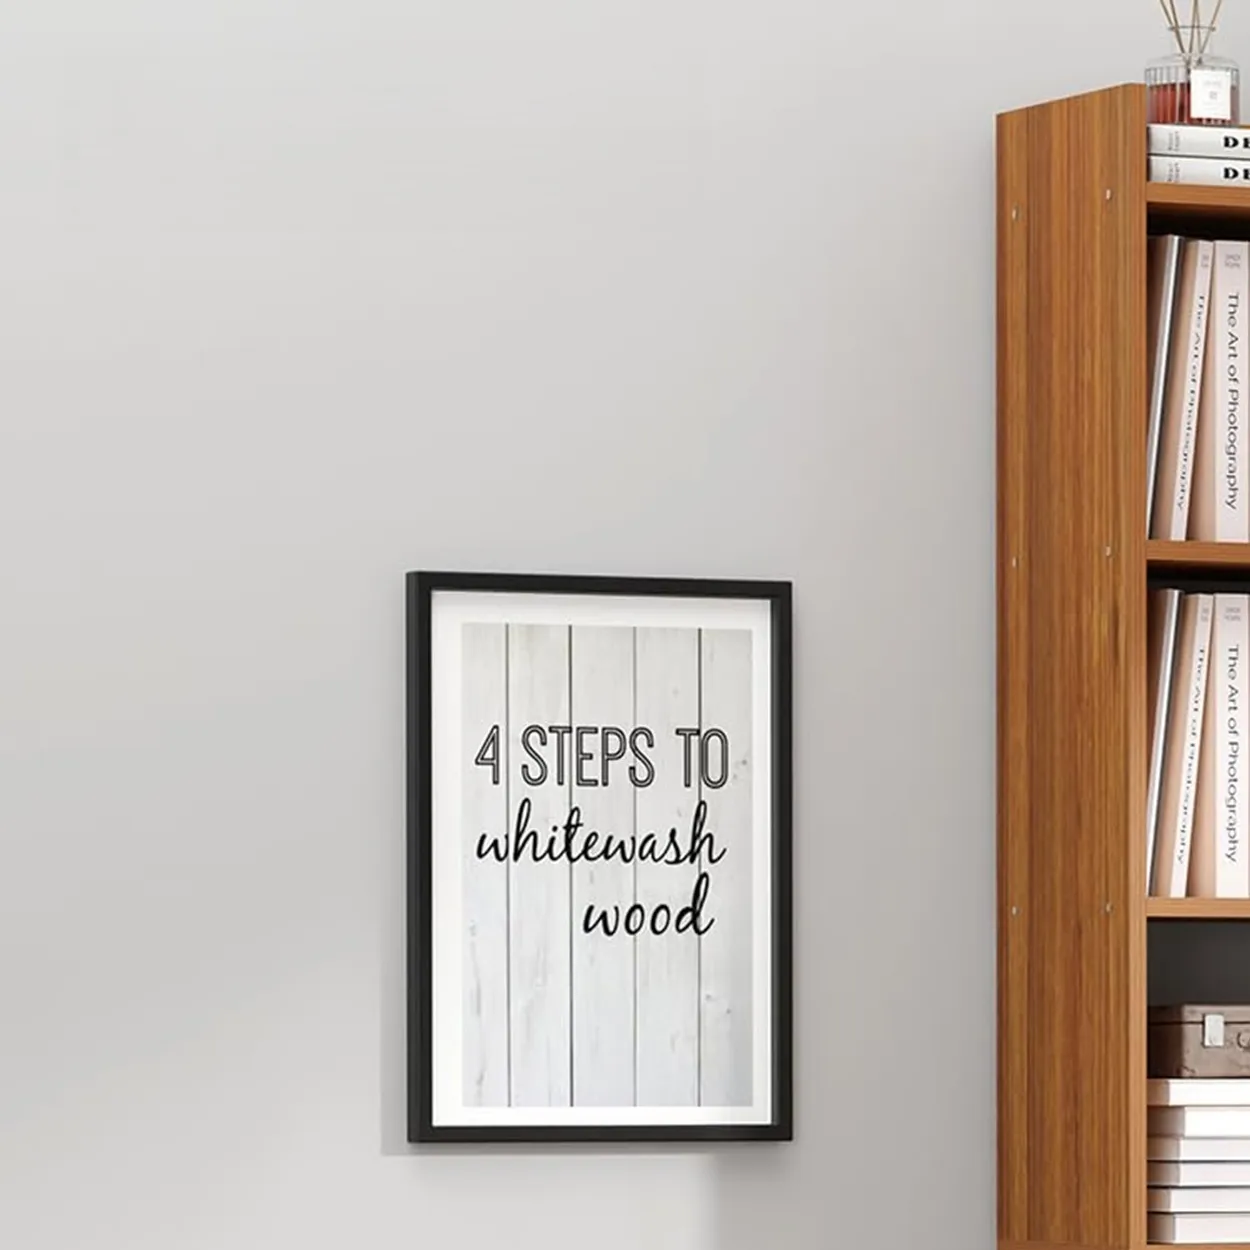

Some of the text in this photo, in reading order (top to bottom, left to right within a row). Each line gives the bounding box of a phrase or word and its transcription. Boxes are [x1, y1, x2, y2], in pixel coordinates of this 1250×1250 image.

[1226, 293, 1240, 510] The Art of Photography
[475, 724, 729, 790] 4 STEPS TO
[1226, 644, 1240, 863] The Art of Photography
[476, 798, 726, 865] whitewash
[582, 872, 714, 937] wood
